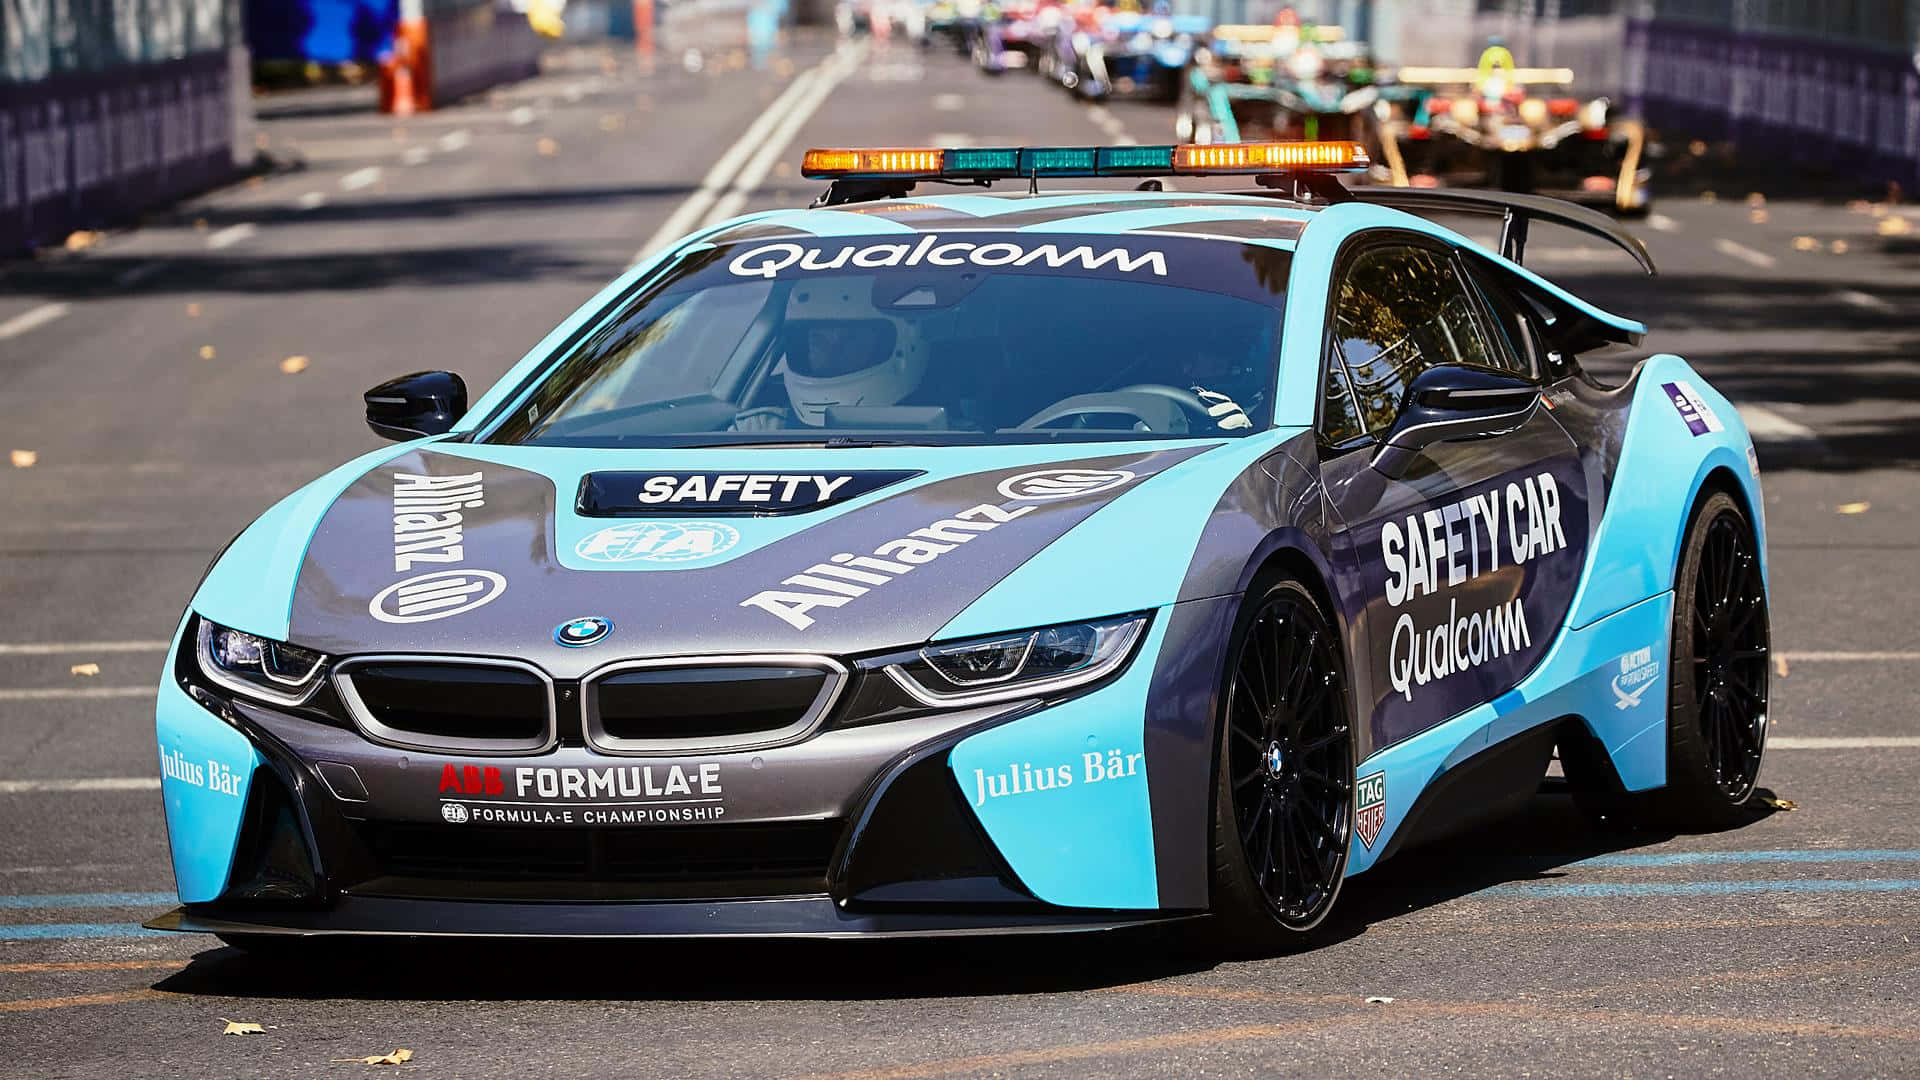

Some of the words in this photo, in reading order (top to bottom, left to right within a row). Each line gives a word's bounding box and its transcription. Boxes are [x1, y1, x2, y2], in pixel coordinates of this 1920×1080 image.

[728, 235, 1168, 278] Qualcomm
[638, 474, 854, 503] SAFETY
[394, 471, 485, 573] Allianz
[584, 528, 716, 554] FIA
[1381, 489, 1499, 607] SAFETY
[1506, 472, 1567, 565] CAR
[739, 503, 1038, 632] Allianz
[1389, 597, 1531, 702] Qualcomm
[160, 744, 204, 788] Julius
[208, 760, 242, 796] Bär
[438, 762, 505, 796] ABB
[515, 763, 723, 799] FORMULA-E
[974, 762, 1073, 807] Julius
[1082, 748, 1143, 785] Bär
[1359, 778, 1383, 805] TAG
[473, 808, 573, 823] FORMULA-E
[583, 806, 725, 824] CHAMPIONSHIP
[1357, 806, 1384, 842] HEUER
